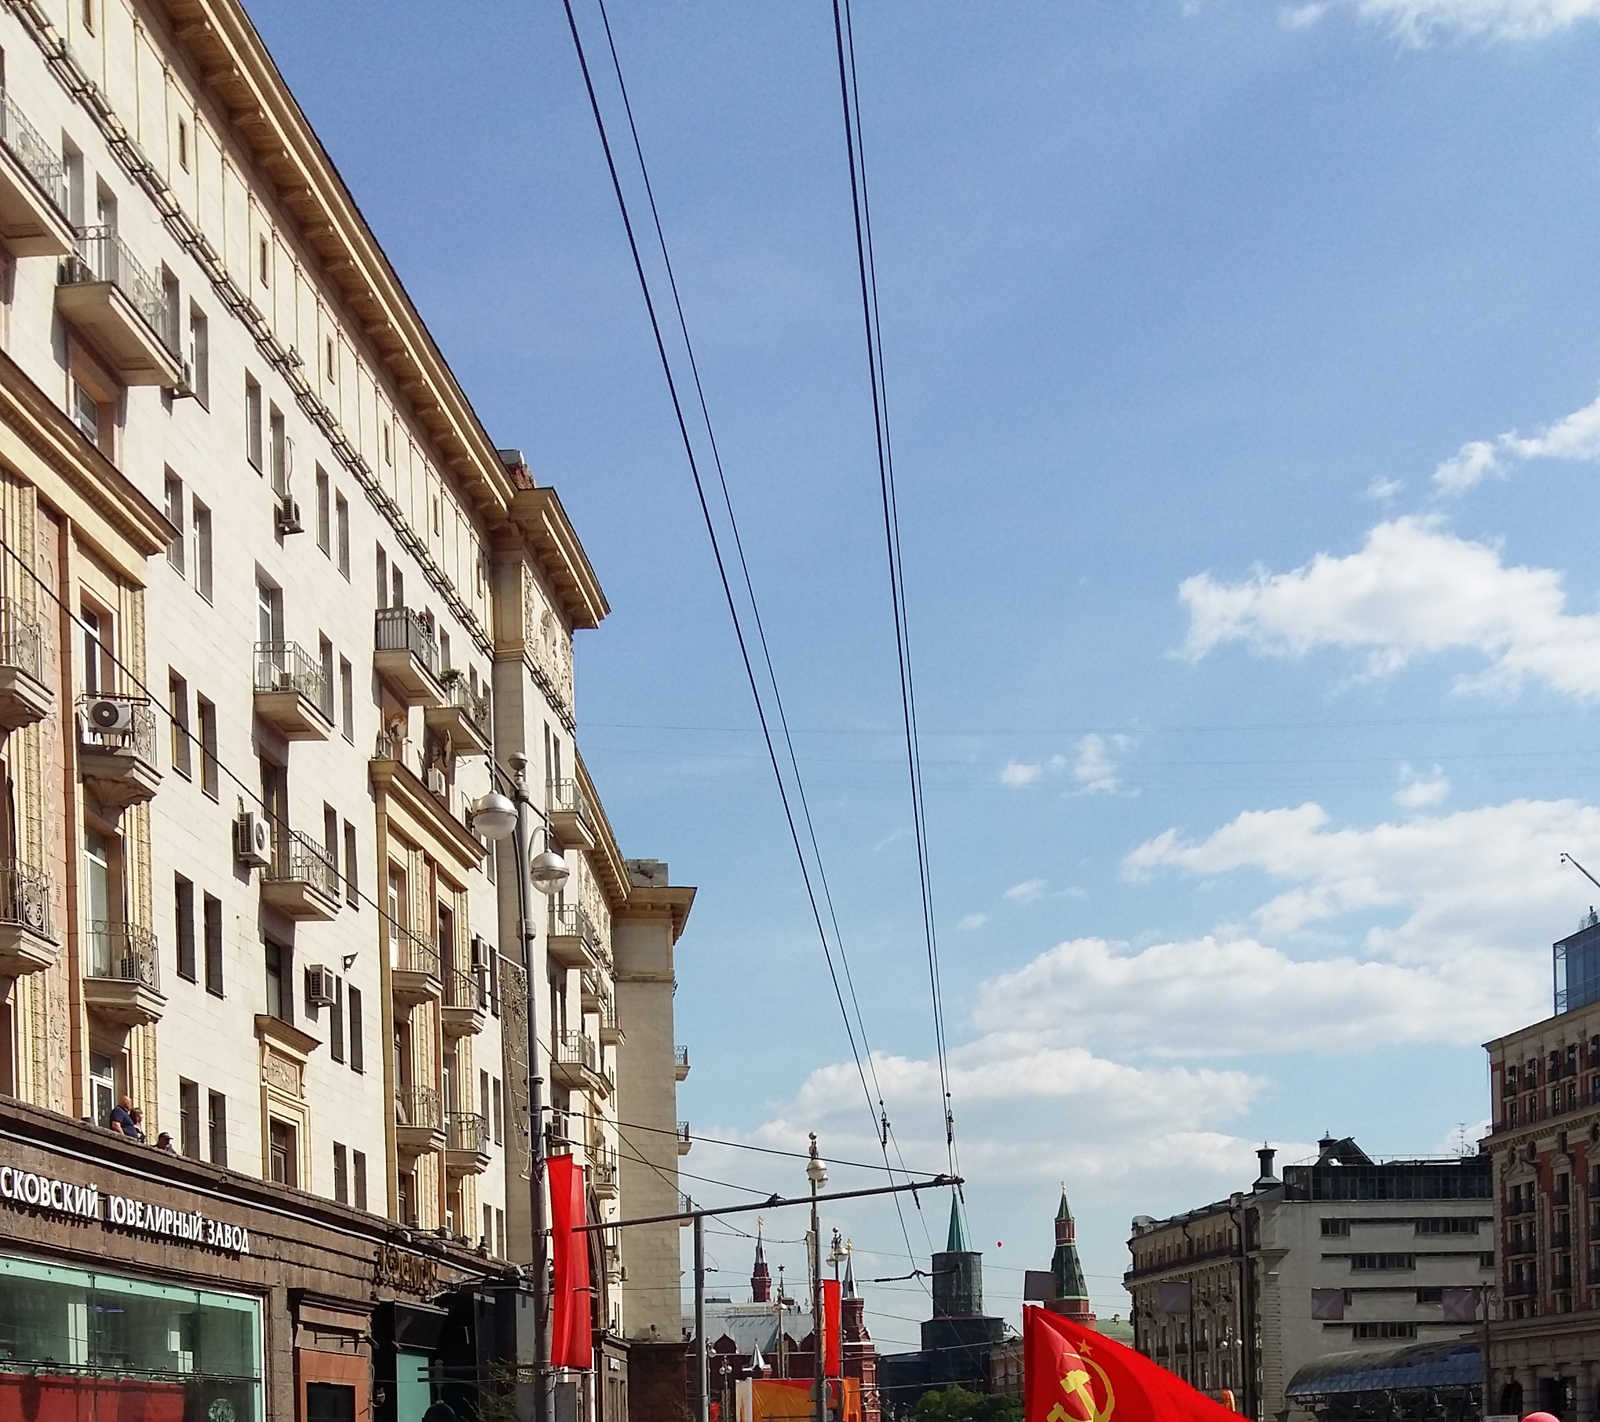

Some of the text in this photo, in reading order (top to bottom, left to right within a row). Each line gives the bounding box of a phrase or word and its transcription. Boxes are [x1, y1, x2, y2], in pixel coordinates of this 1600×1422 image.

[0, 1166, 250, 1254] СКОВСКИЙ ЮВЕЛИРНЫЙ ЗАВОД
